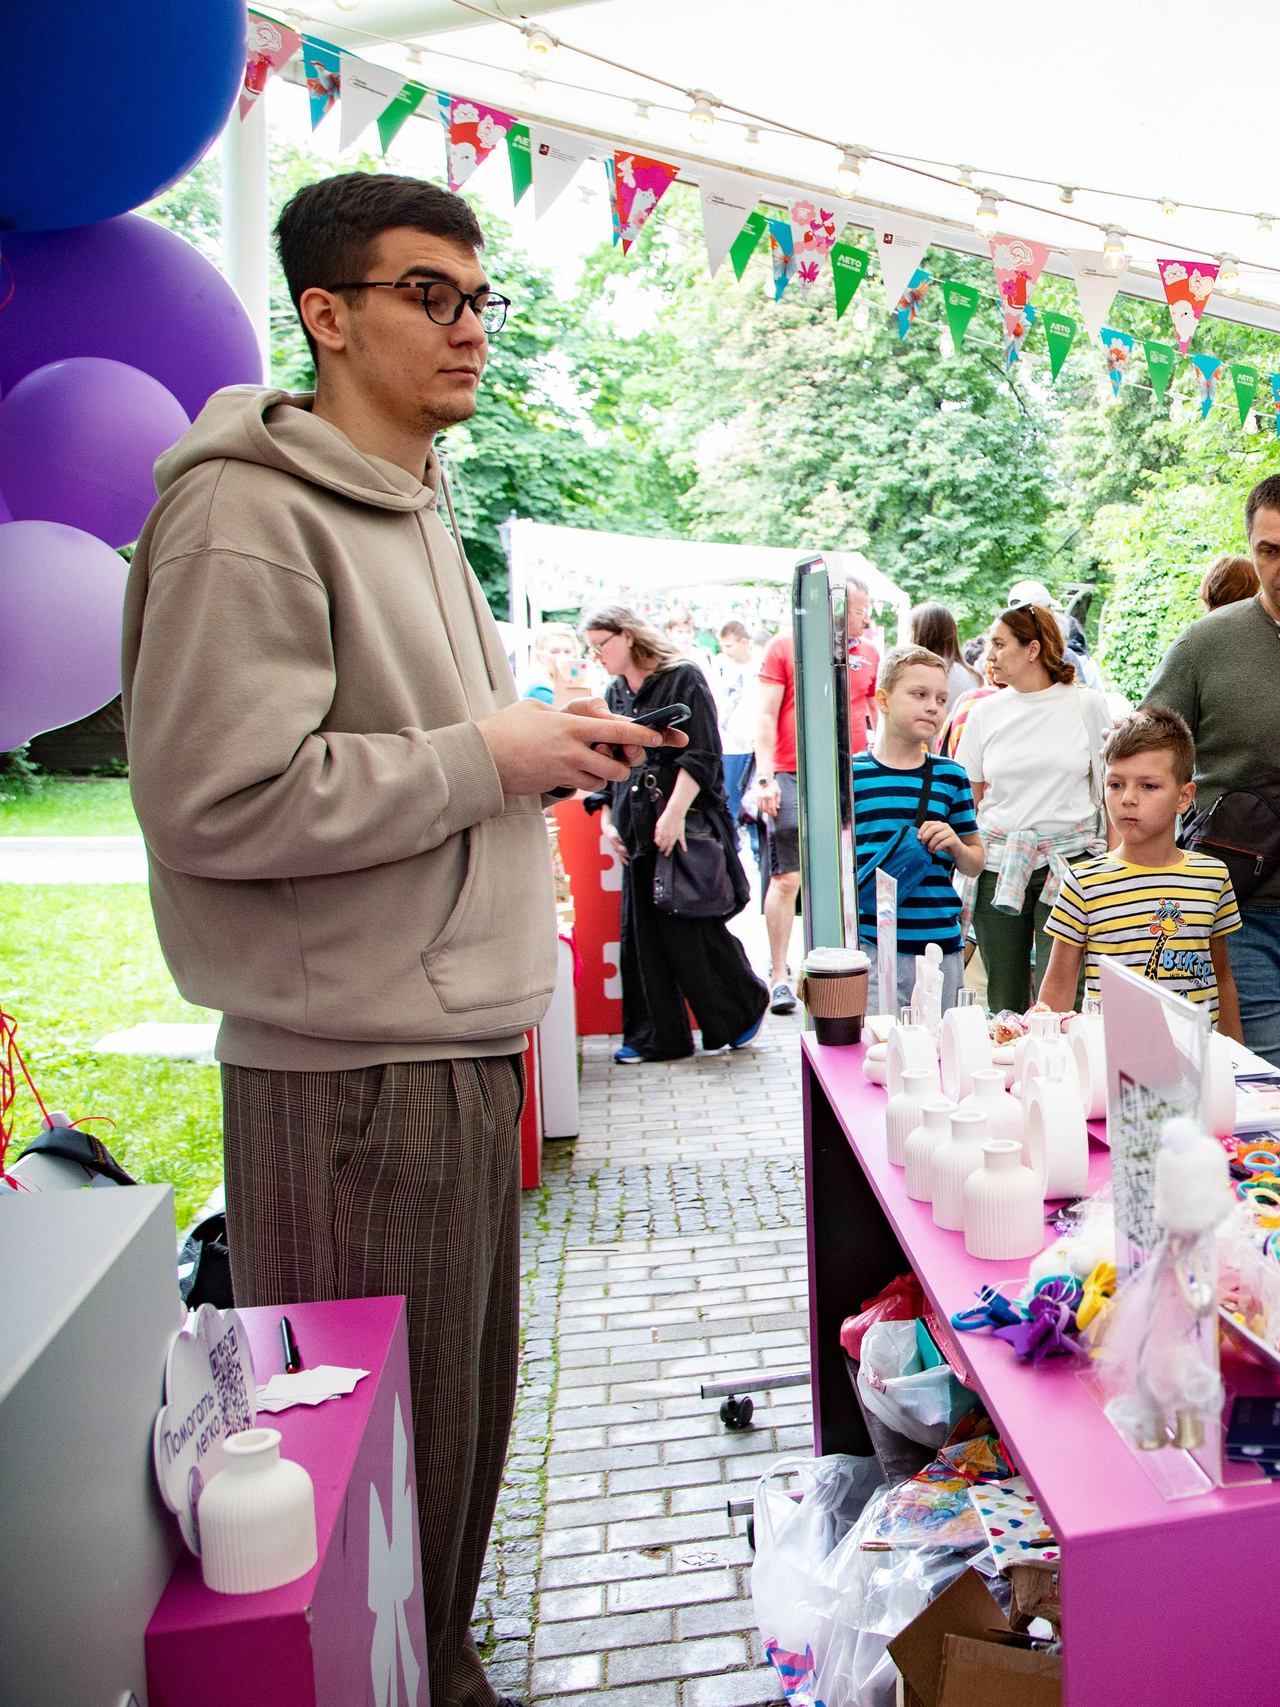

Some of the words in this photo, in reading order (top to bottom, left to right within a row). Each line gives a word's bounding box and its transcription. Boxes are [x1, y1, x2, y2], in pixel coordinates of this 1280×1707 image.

[513, 134, 530, 147] ЛЕ
[838, 254, 862, 268] ЛЕТО
[1050, 322, 1071, 333] ЛЕТО
[1237, 373, 1254, 383] ЛЕТО
[1163, 949, 1211, 985] BIKER
[164, 1391, 215, 1464] Помогать
[195, 1415, 221, 1463] легко
